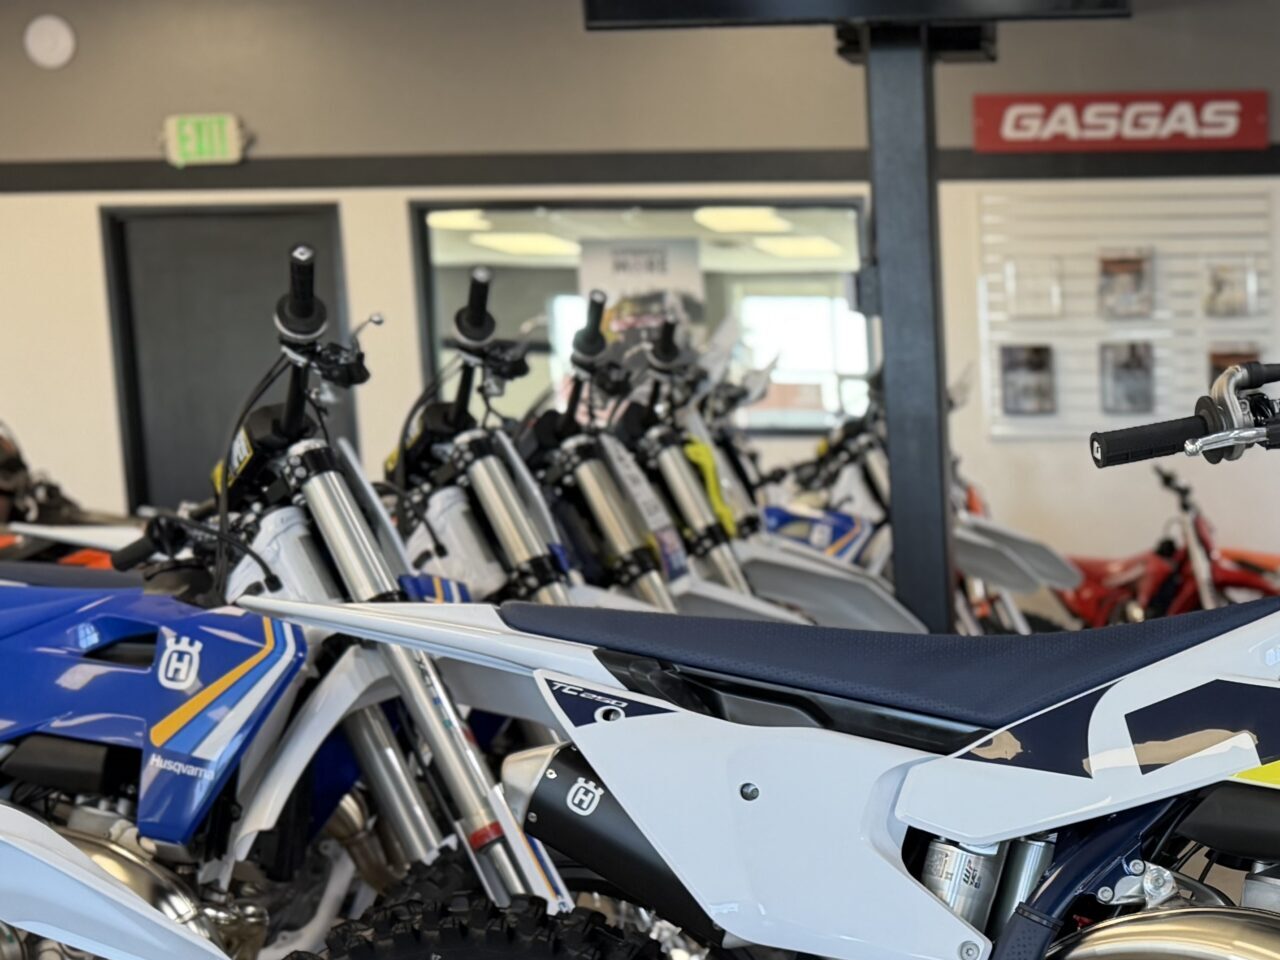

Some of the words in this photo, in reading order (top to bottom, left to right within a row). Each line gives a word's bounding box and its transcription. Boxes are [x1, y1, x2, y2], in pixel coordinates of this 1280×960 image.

[177, 115, 228, 160] EXIT
[1001, 101, 1242, 141] GASGAS
[552, 681, 584, 696] TC
